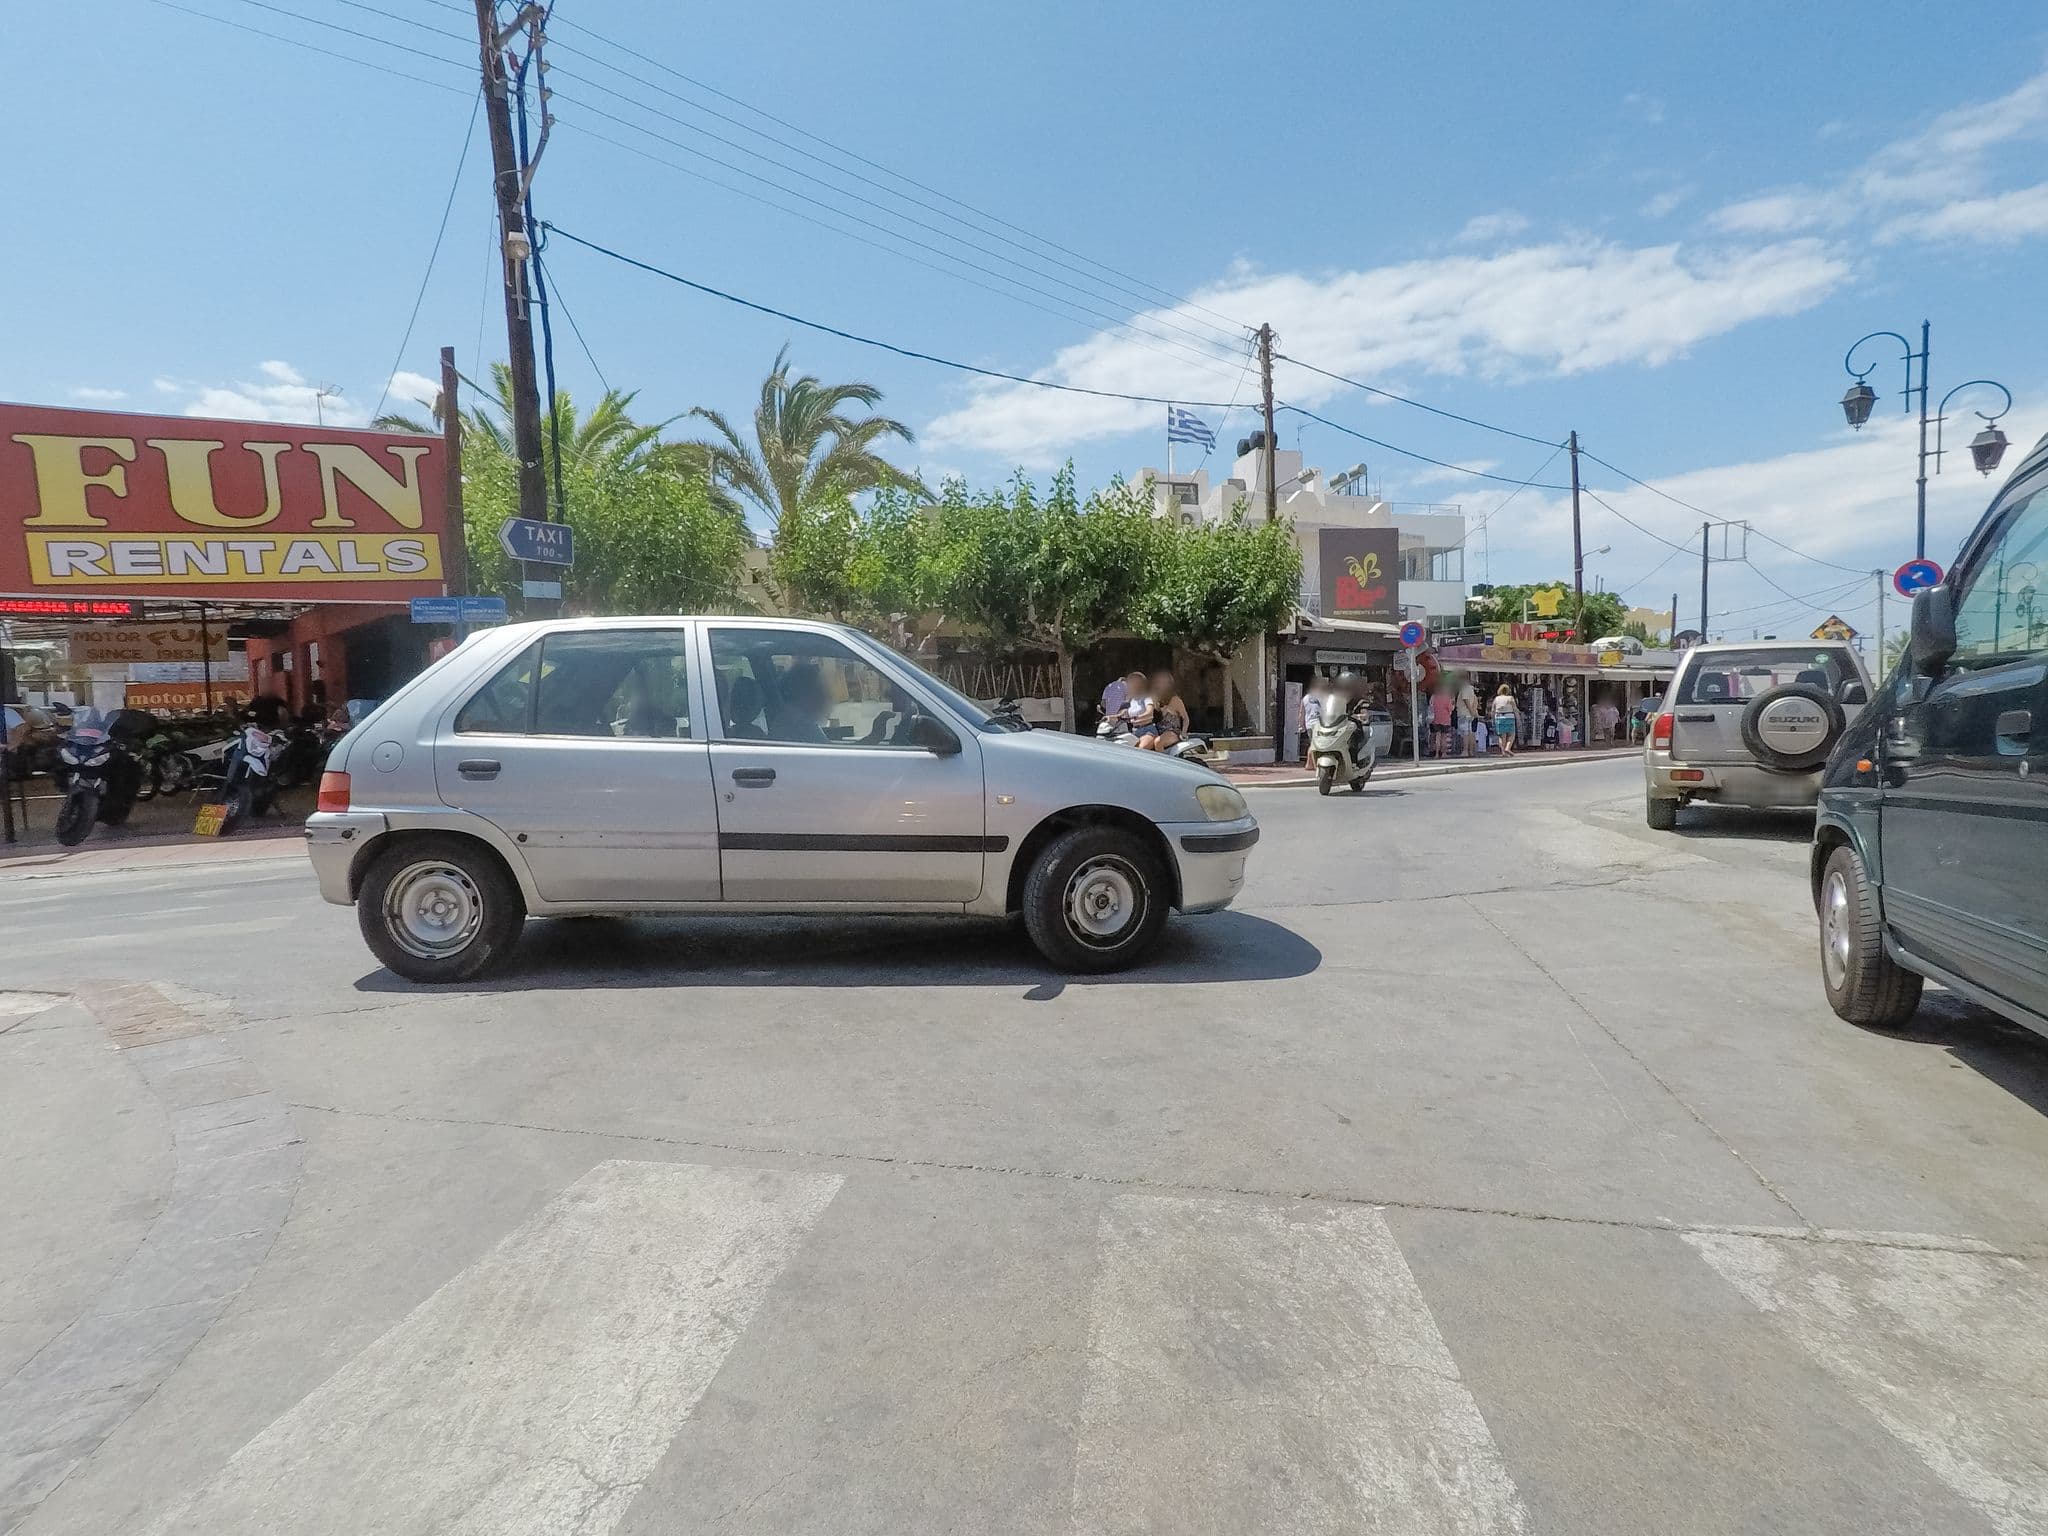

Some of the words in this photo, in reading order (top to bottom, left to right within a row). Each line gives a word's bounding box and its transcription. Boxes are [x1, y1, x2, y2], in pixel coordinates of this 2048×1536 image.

[12, 434, 430, 529] FUN
[525, 526, 563, 544] TAXI
[46, 539, 429, 577] RENTALS
[537, 547, 555, 557] 100
[73, 631, 141, 642] MOTOR
[147, 629, 223, 646] FUN
[87, 649, 143, 660] SINCE
[129, 692, 195, 705] motor
[1769, 716, 1820, 724] SUZUKI
